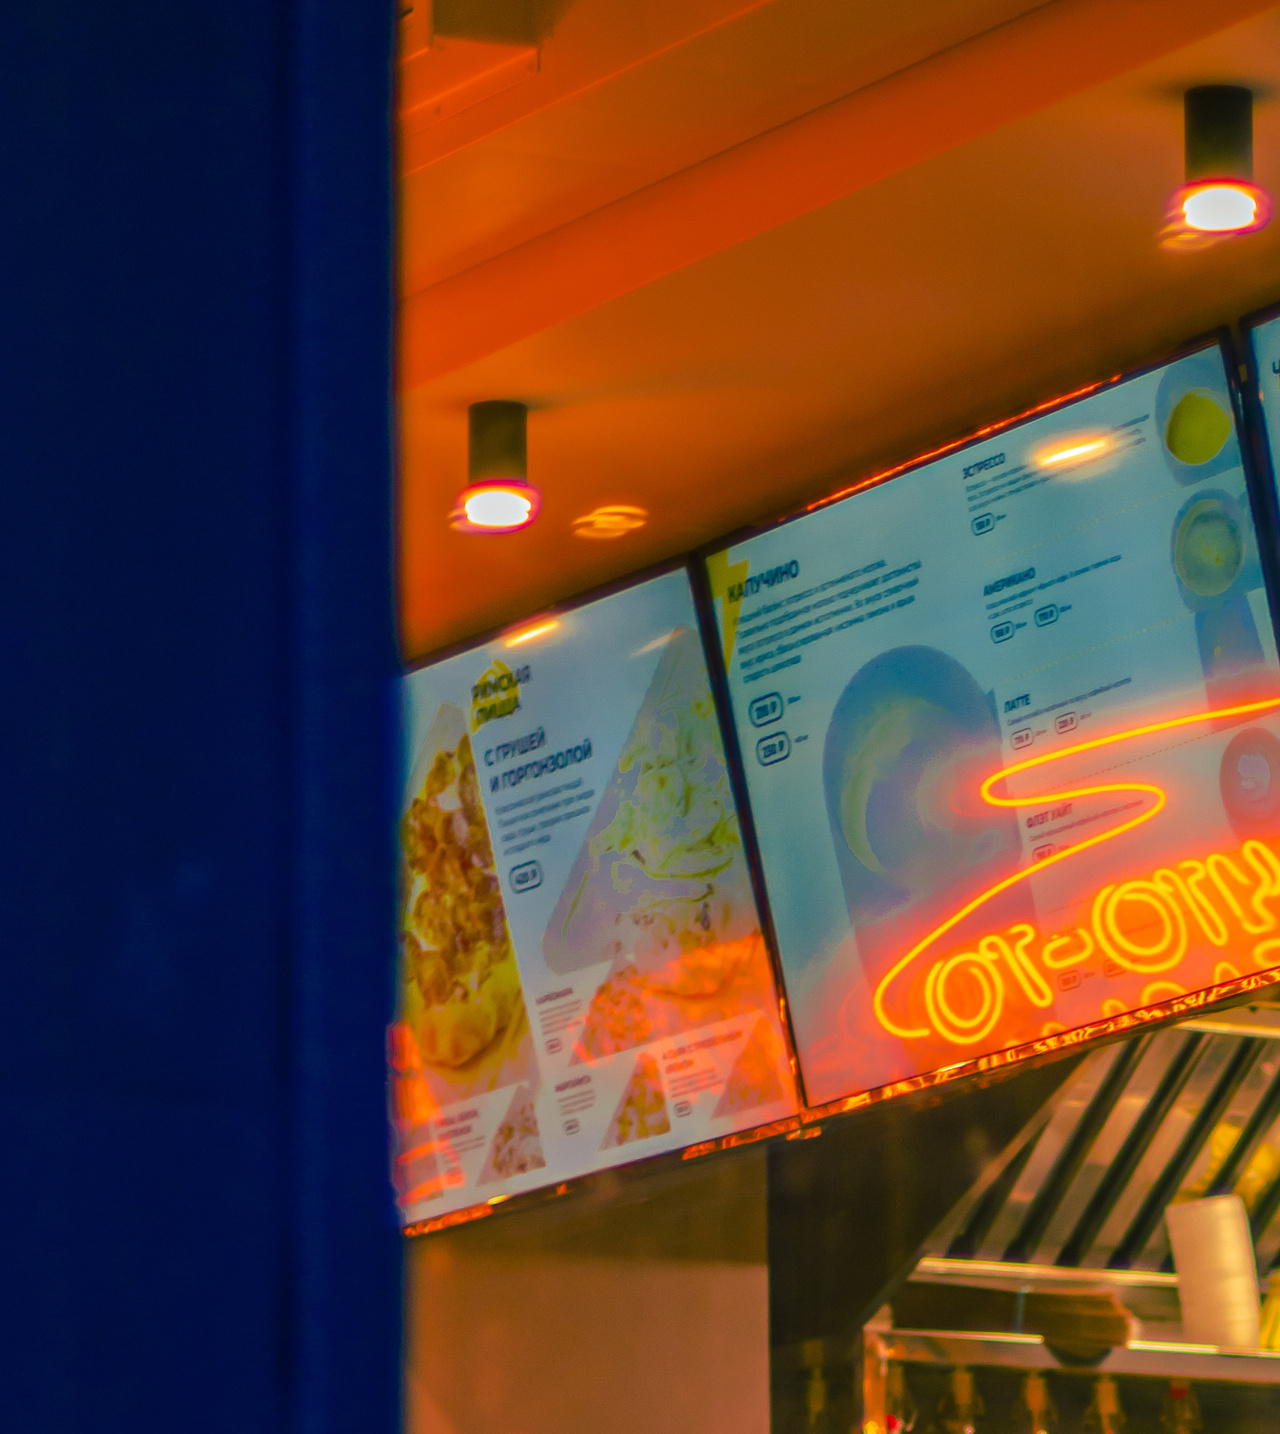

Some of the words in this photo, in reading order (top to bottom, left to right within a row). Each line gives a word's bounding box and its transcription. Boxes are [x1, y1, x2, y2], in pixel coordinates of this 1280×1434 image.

[727, 559, 800, 604] КАПУЧИНО
[484, 748, 495, 768] С
[489, 773, 500, 793] И
